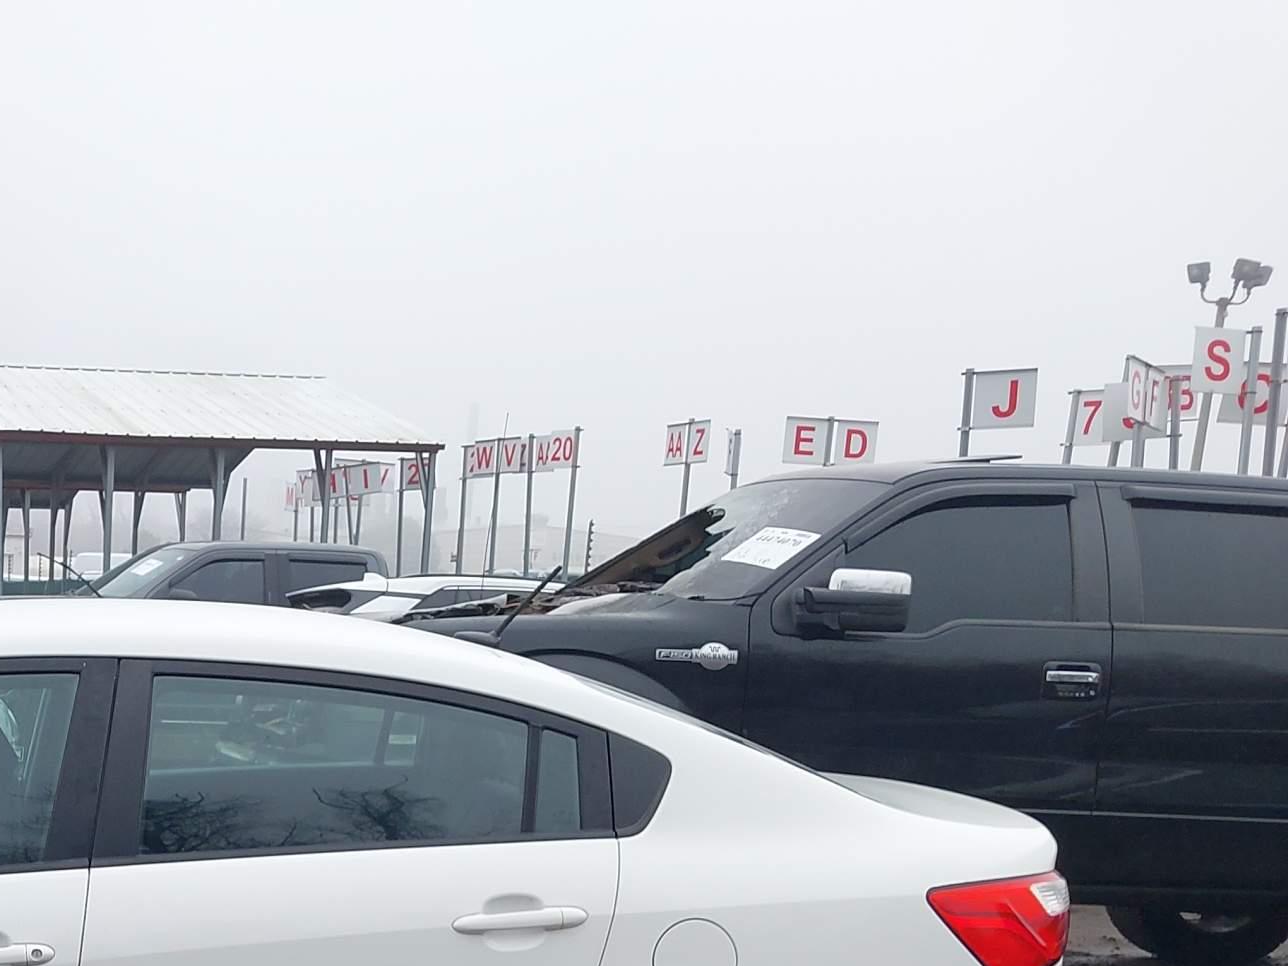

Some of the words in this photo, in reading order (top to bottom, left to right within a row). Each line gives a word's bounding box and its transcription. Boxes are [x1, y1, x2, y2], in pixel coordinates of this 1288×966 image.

[1204, 339, 1232, 382] S
[991, 379, 1020, 419] J
[1131, 370, 1142, 411] G
[1083, 400, 1103, 435] 7
[504, 443, 517, 467] V
[551, 436, 573, 462] 20
[666, 431, 682, 458] AA
[692, 428, 705, 456] Z
[793, 425, 816, 456] E
[843, 428, 868, 459] D
[476, 446, 493, 470] W
